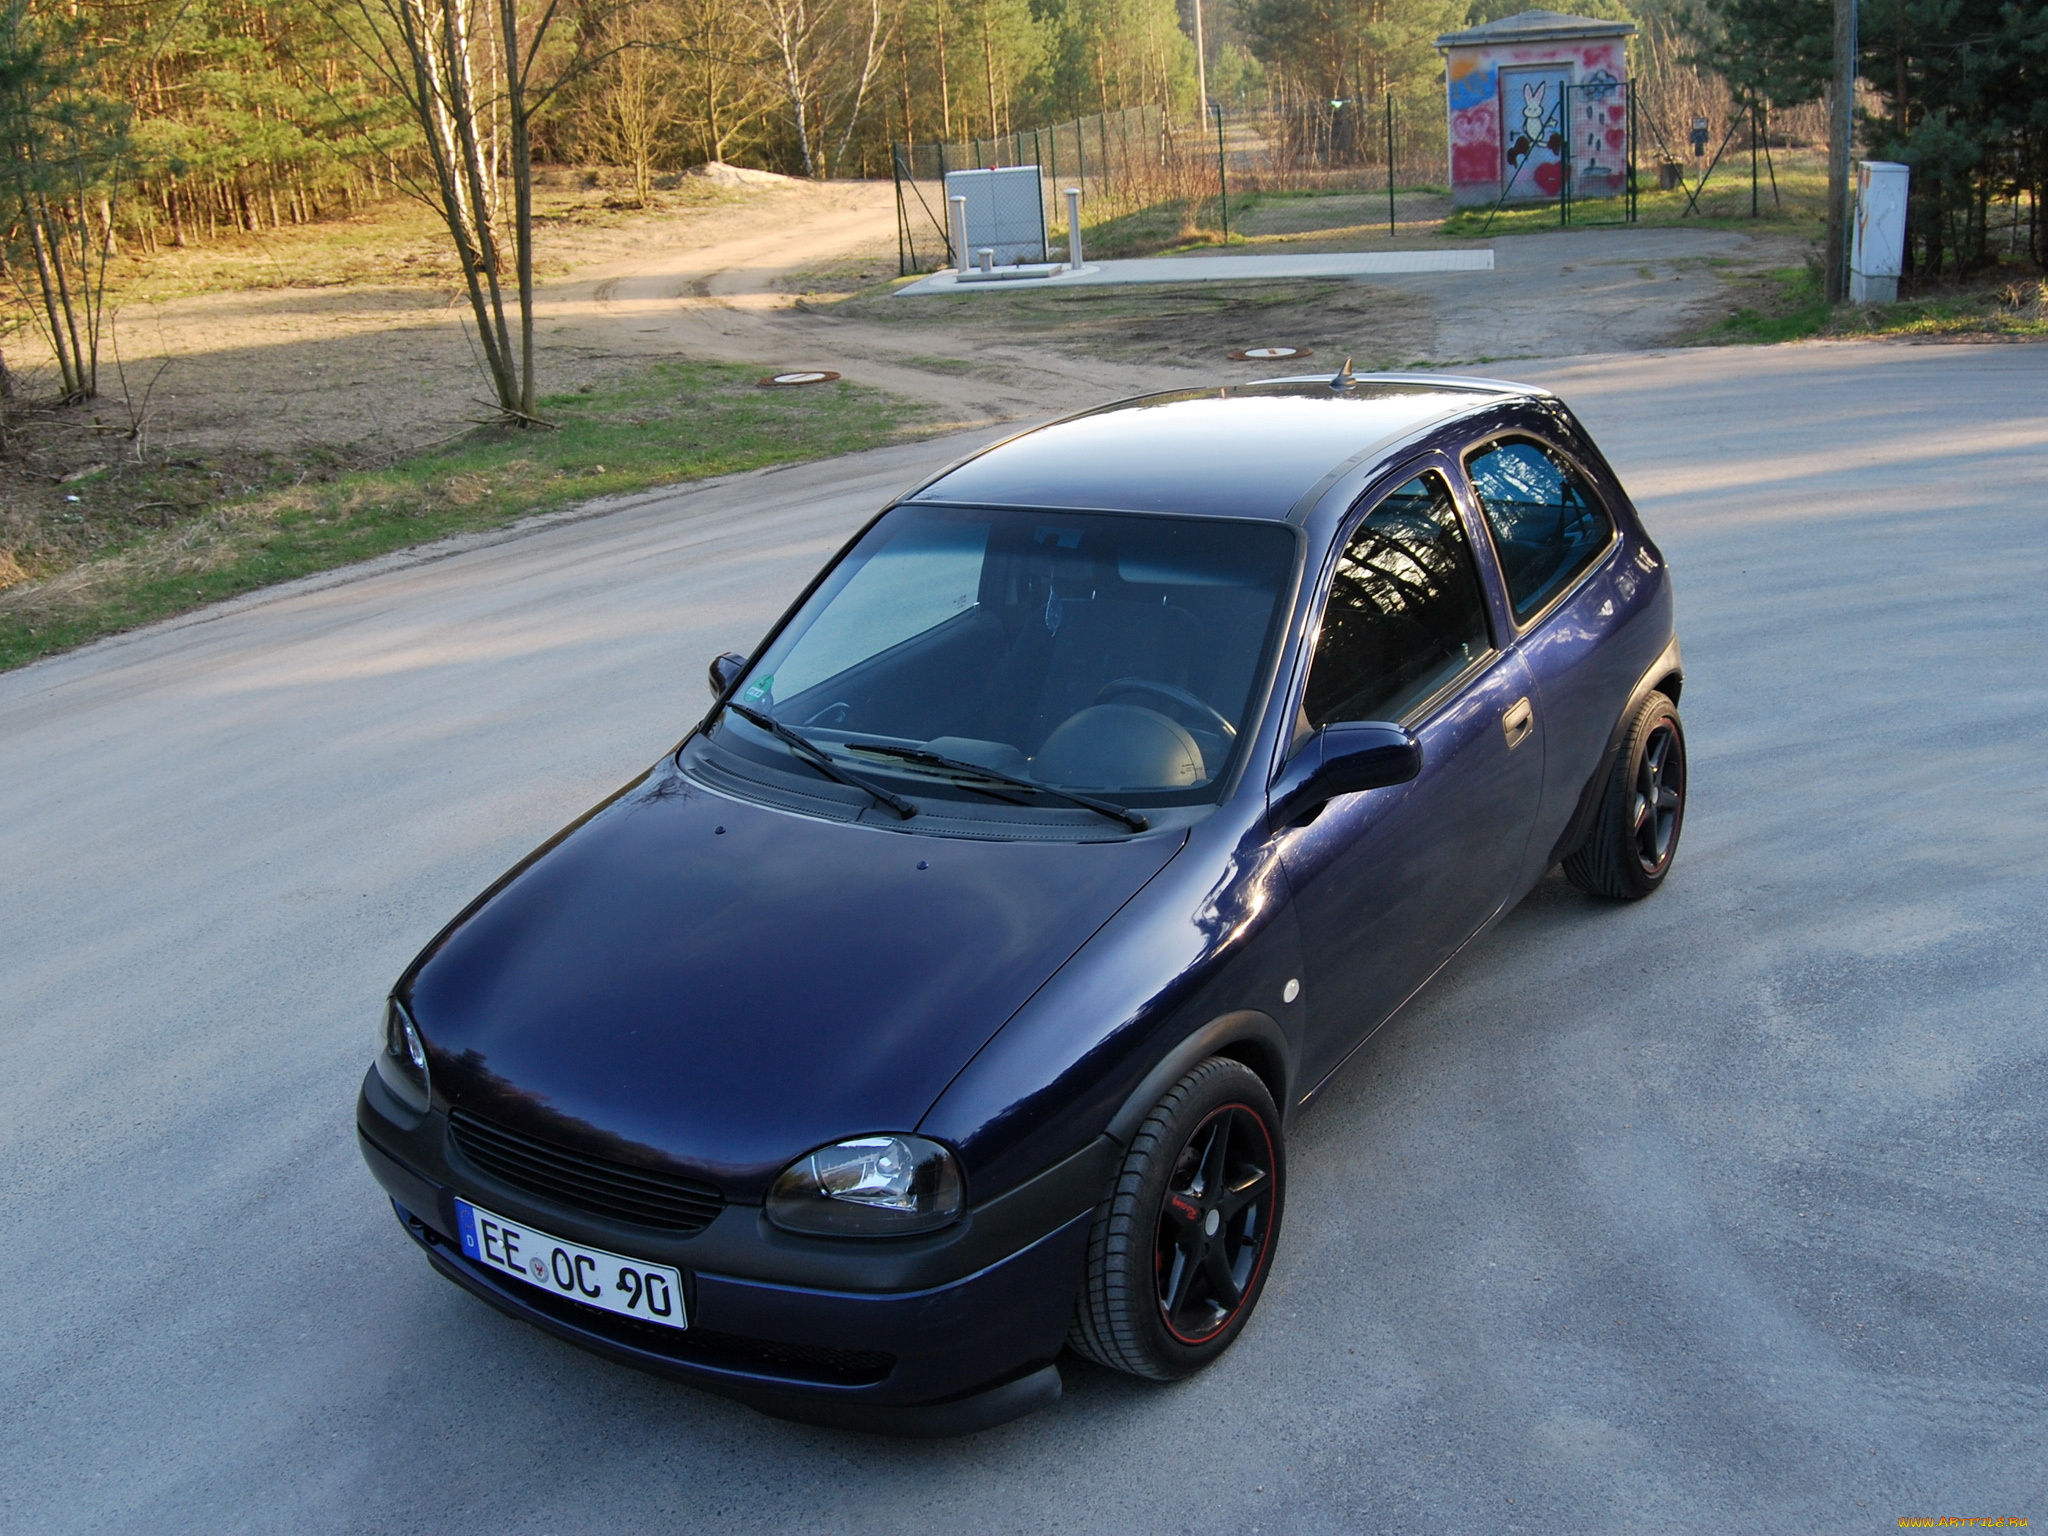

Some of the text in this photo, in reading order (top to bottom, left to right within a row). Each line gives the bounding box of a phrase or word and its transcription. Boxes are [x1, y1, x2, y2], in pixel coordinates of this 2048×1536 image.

[467, 1234, 475, 1247] D
[481, 1218, 672, 1317] EE OC 90
